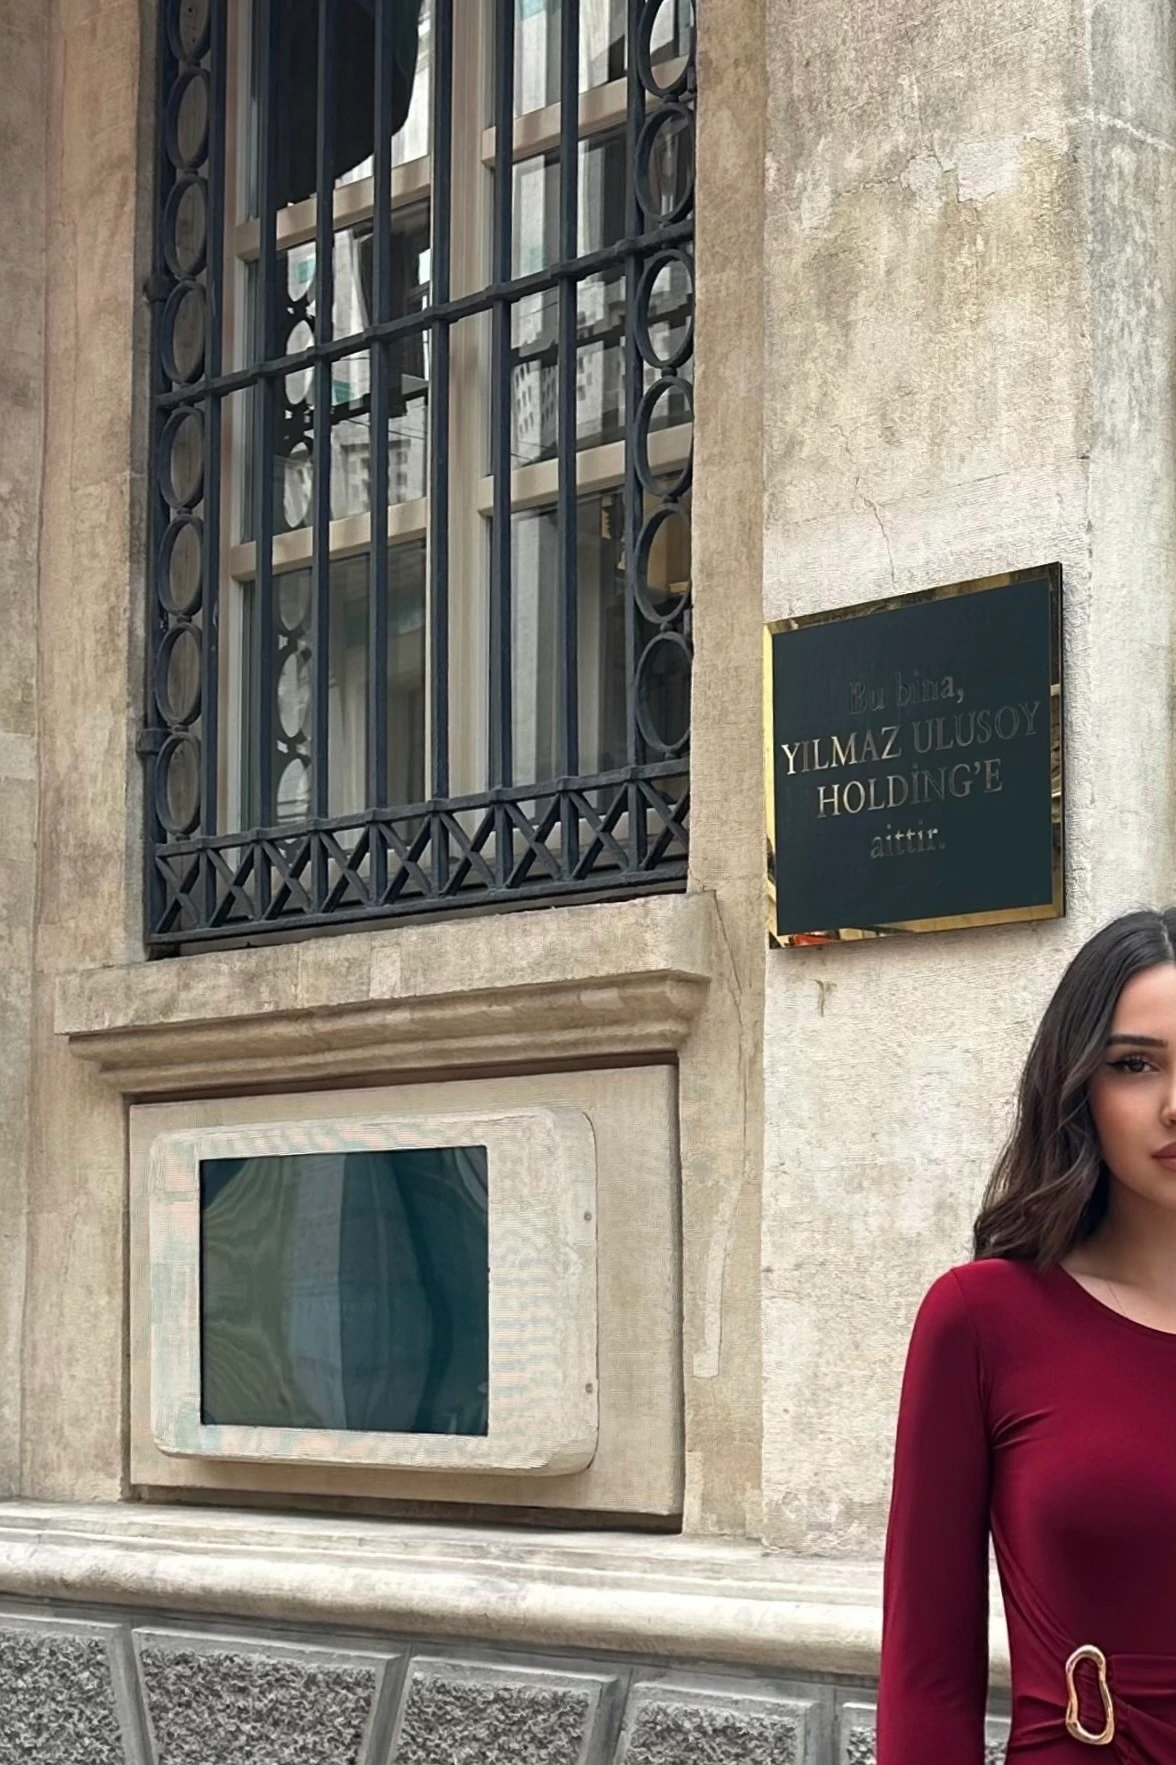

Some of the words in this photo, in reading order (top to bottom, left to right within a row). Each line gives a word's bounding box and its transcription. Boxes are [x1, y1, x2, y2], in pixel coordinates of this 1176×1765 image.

[850, 680, 885, 715] Bu
[896, 670, 965, 704] bina,
[781, 726, 902, 775] YILMAZ
[913, 701, 1041, 753] ULUSOY
[870, 820, 946, 859] aittir.
